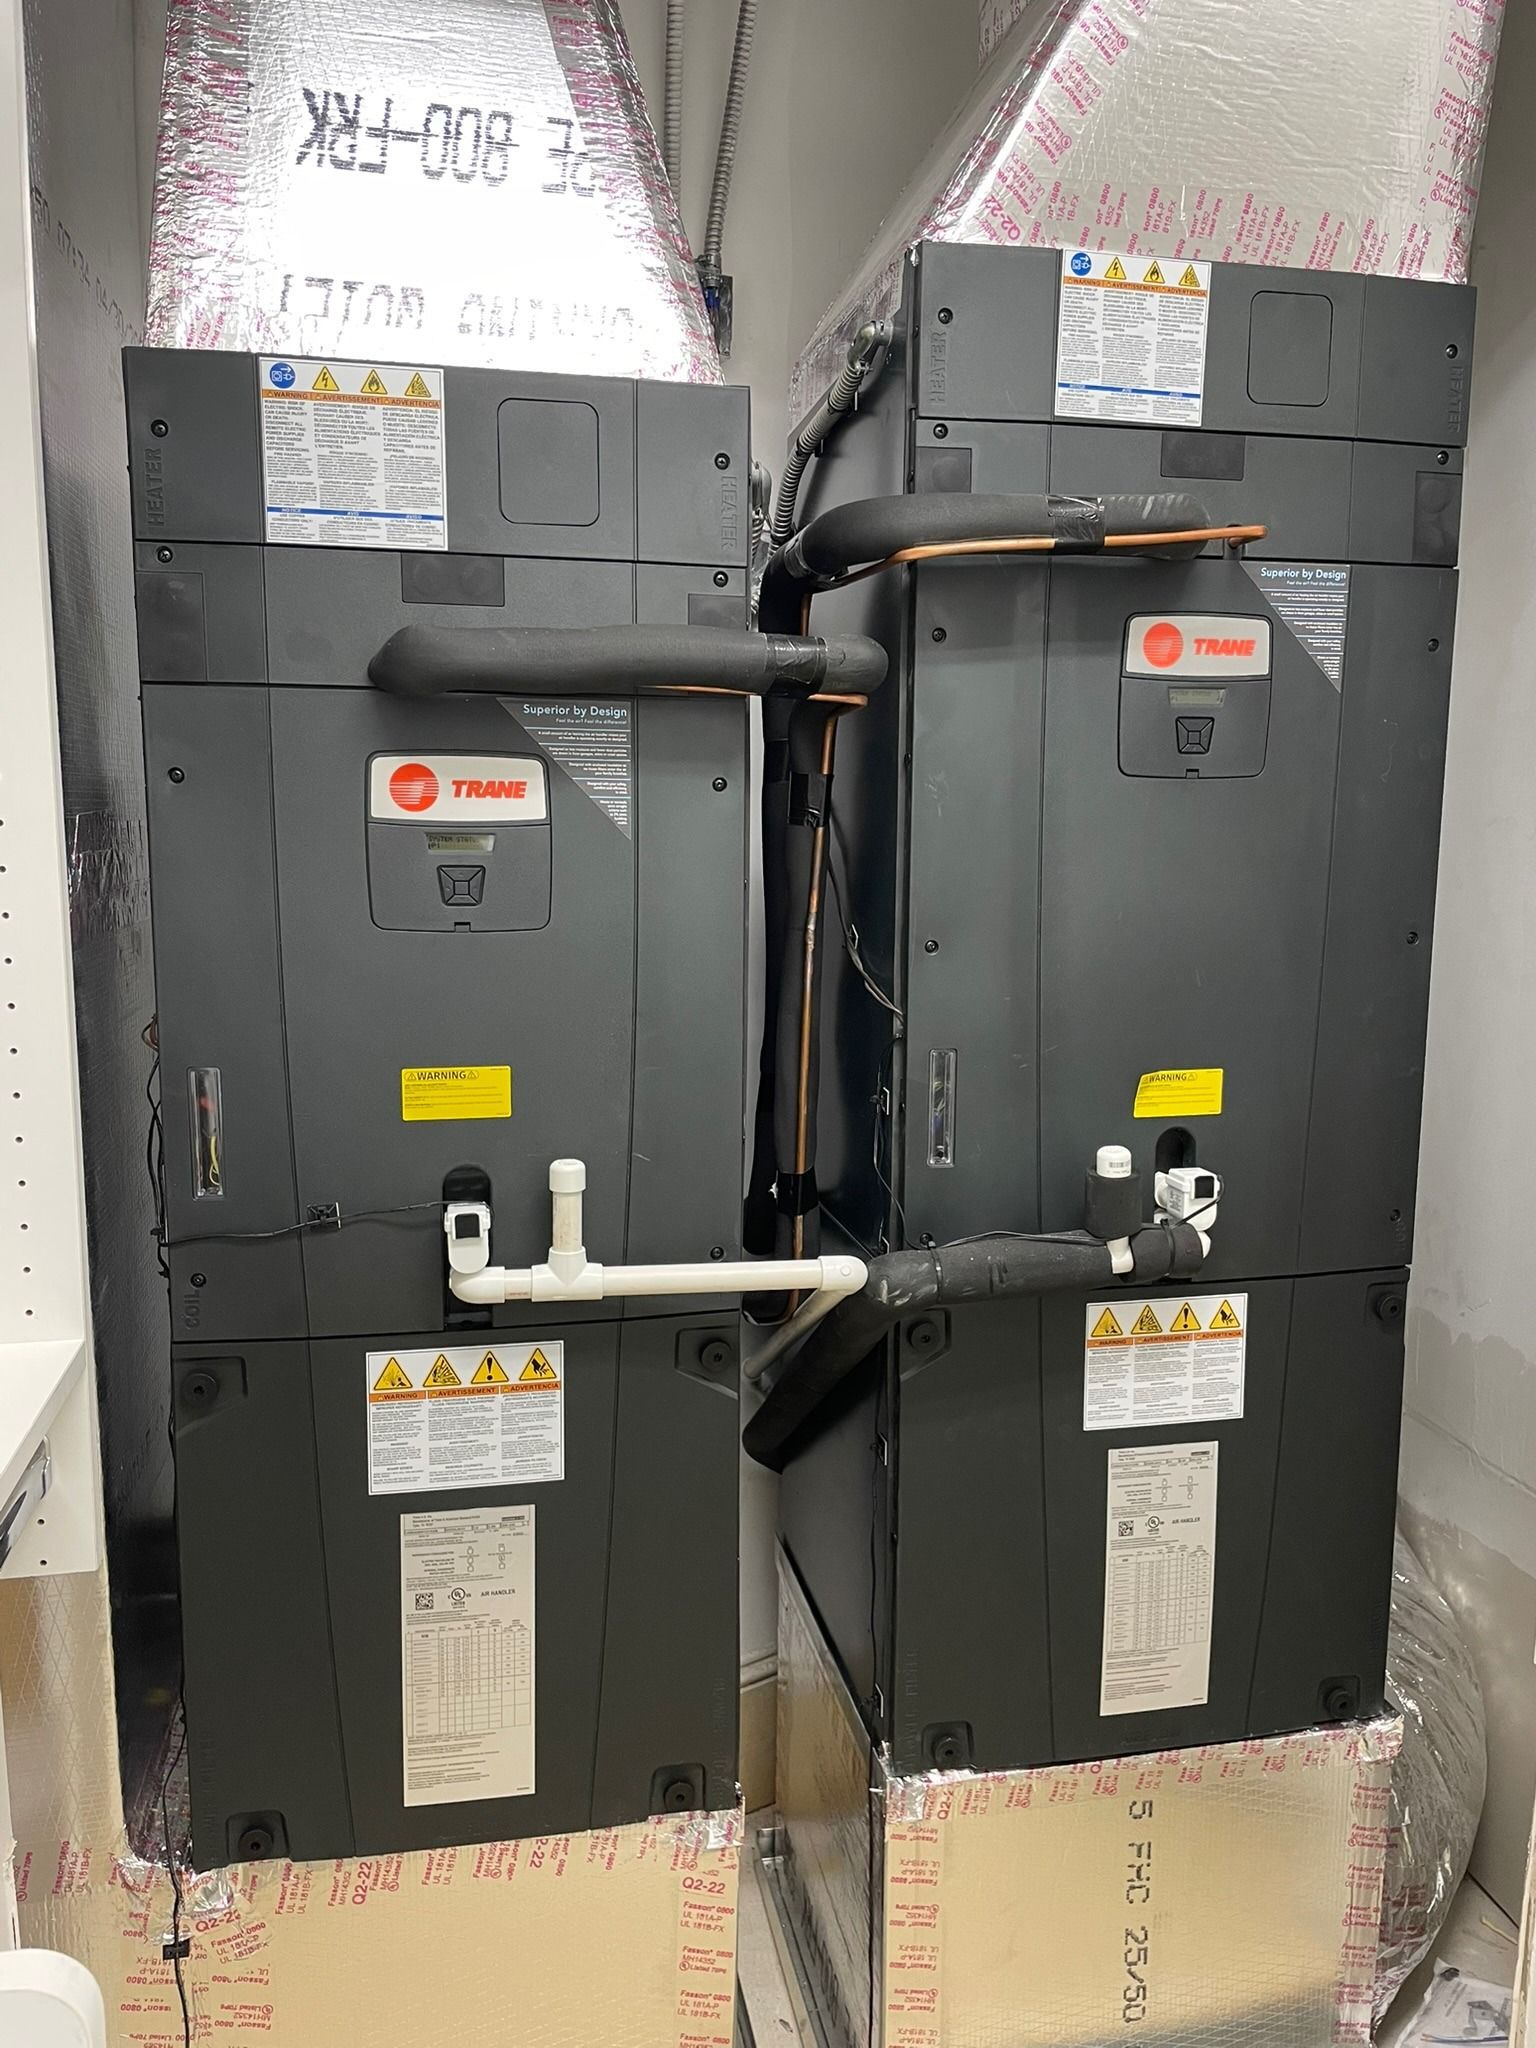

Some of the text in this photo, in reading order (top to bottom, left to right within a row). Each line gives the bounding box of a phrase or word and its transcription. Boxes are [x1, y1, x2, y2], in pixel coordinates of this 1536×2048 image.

[1051, 181, 1062, 204] 0800
[1100, 184, 1111, 205] 0800
[1148, 187, 1160, 208] 0800
[1196, 189, 1207, 210] 0800
[1244, 192, 1254, 215] 0800
[1246, 206, 1259, 241] 181A-P
[1254, 205, 1270, 244] 181B-FX
[1273, 206, 1286, 228] 0800
[1319, 212, 1331, 233] 0800
[1030, 221, 1042, 244] 0800
[1078, 226, 1090, 247] 0800
[1274, 220, 1289, 253] 181A-P
[1363, 218, 1374, 240] 0800
[1407, 223, 1418, 243] 0800
[1127, 233, 1138, 254] 0800
[930, 331, 946, 403] HEATER
[274, 392, 308, 400] WARNING
[323, 395, 380, 404] AVERTISSEMENT
[145, 448, 164, 525] HEATER
[721, 476, 737, 550] HEATER
[1260, 568, 1346, 580] Superior by Design
[1194, 639, 1256, 656] TRANE
[524, 704, 627, 718] Superior by Design
[452, 781, 527, 798] TRANE
[417, 1071, 466, 1080] WARNING
[1150, 1073, 1187, 1082] WARNING
[438, 1388, 496, 1396] AVERTISSEMENT
[510, 1383, 559, 1391] ADVERTENCIA
[491, 1588, 516, 1596] HANDLER
[1129, 1800, 1153, 1820] 5
[60, 1840, 70, 1860] 0800
[282, 1862, 293, 1882] 0800
[380, 1856, 394, 1890] MH14352
[555, 1858, 566, 1877] 0800
[338, 1872, 351, 1905] MH14352
[352, 1862, 373, 1905] Q2-22
[432, 1874, 441, 1884] UL
[682, 1876, 726, 1894] Q2-22
[286, 1874, 300, 1914] UL 181A-P
[297, 1869, 314, 1915] UL 181B-FX
[683, 1911, 723, 1922] UL 181A-P
[716, 1906, 734, 1914] 0800
[246, 1922, 266, 1934] 0800
[680, 1920, 725, 1933] UL 181B-FX
[216, 1947, 228, 1956] UL
[220, 1955, 232, 1965] UL
[682, 1955, 716, 1965] MH14352
[716, 1950, 733, 1958] 0800
[690, 1964, 709, 1972] Listed
[1122, 1926, 1148, 2024] 25/50
[126, 1976, 147, 1984] 0800
[680, 1999, 720, 2009] UL 181A-P
[713, 1994, 731, 2002] 0800
[120, 2004, 141, 2012] 0800
[677, 2008, 721, 2019] UL 181B-FX
[215, 2020, 234, 2028] 0800
[712, 2037, 730, 2045] 0800
